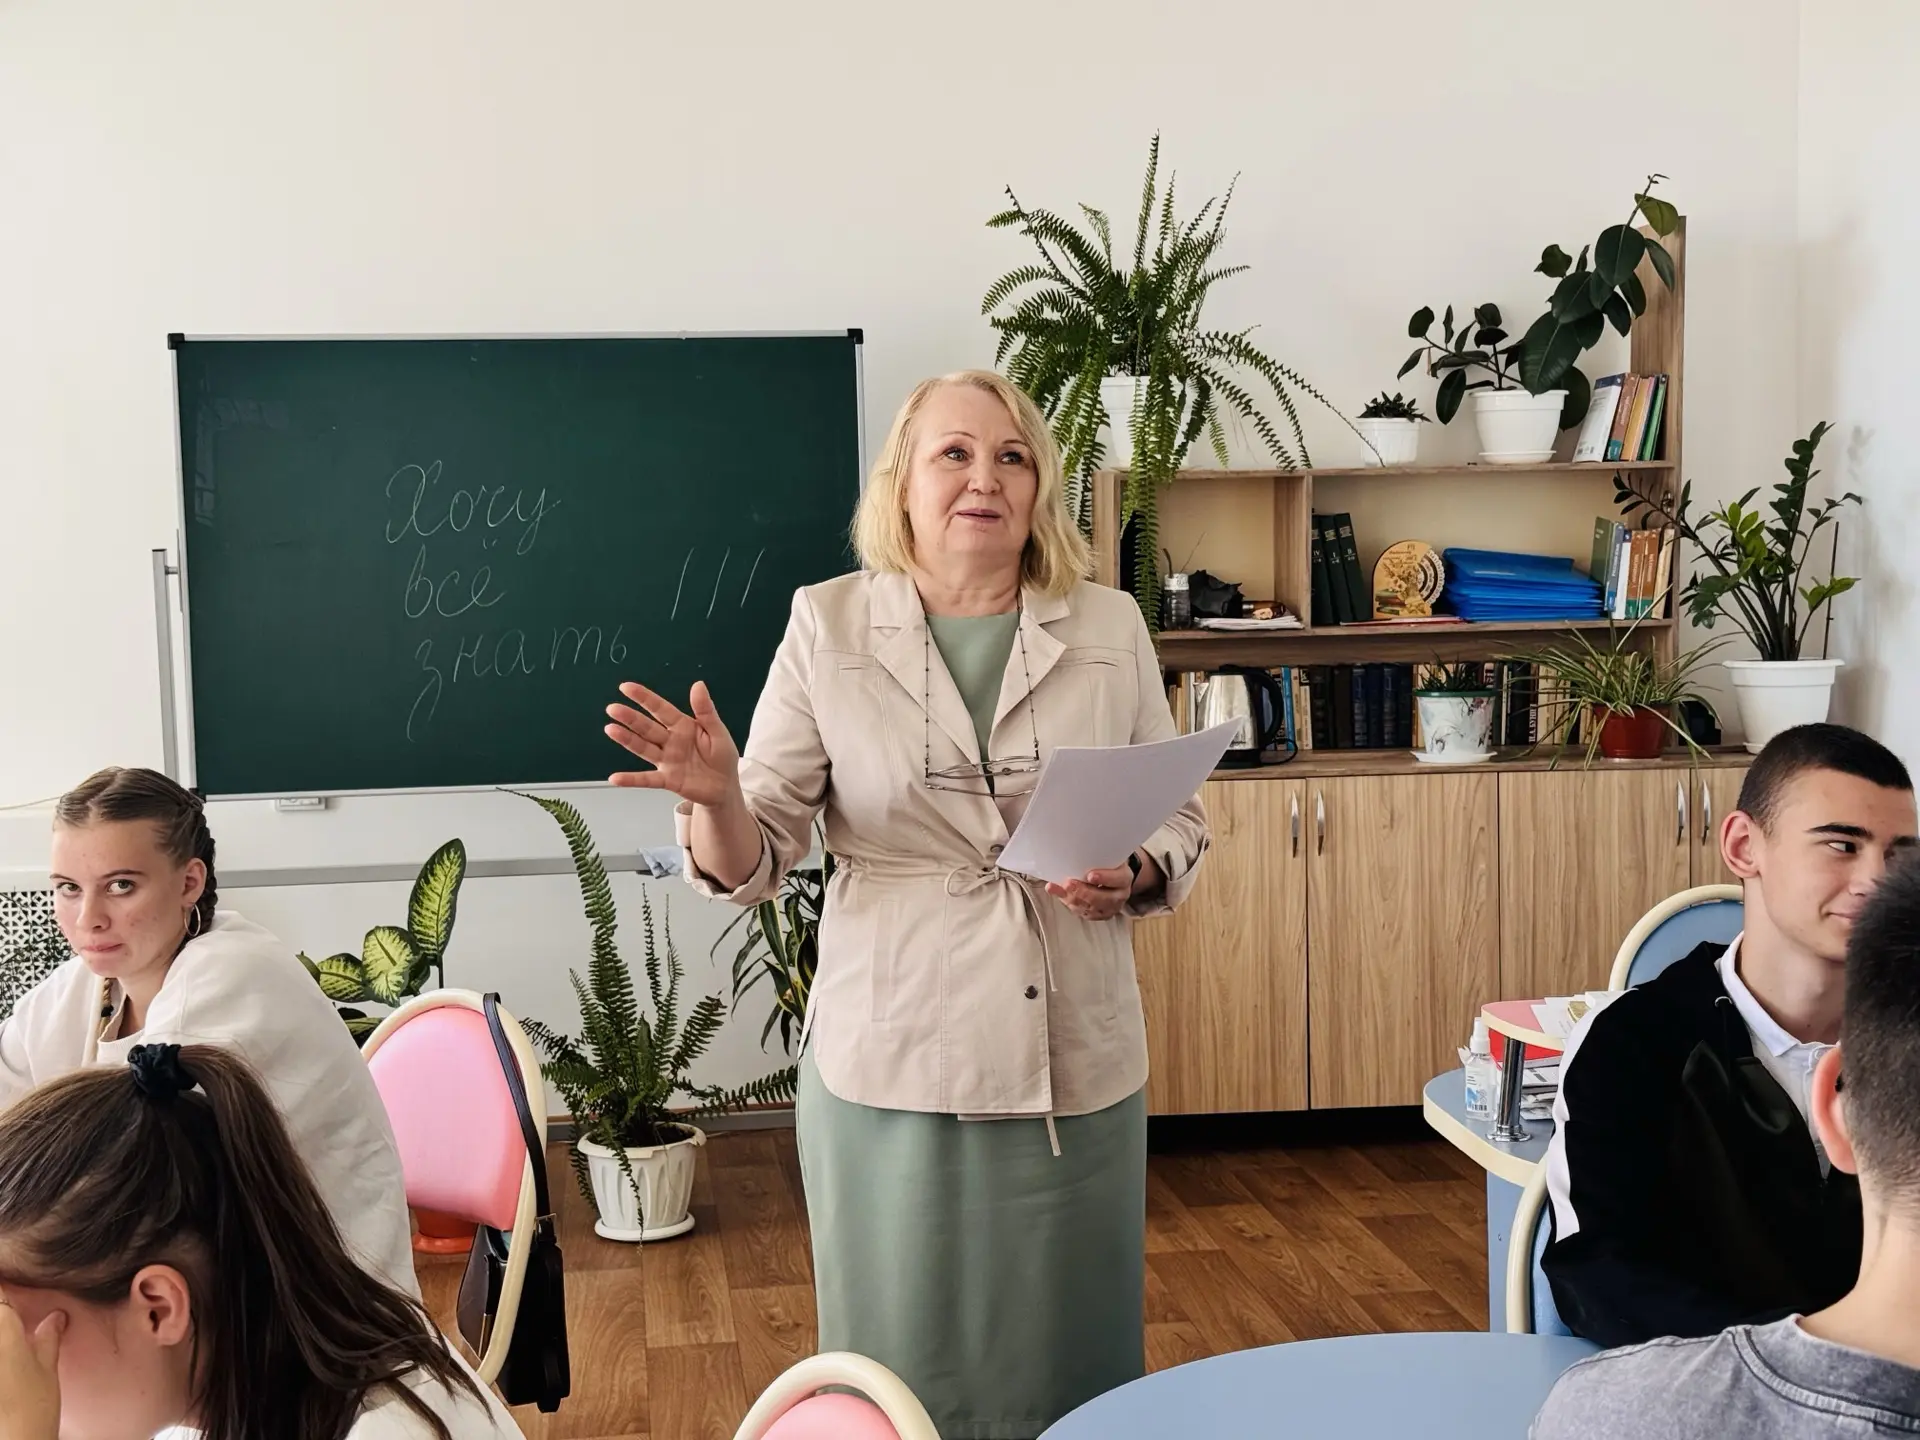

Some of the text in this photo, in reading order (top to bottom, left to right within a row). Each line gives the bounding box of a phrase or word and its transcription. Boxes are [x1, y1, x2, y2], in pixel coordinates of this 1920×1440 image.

[385, 459, 562, 556] Хочу
[404, 537, 508, 619] всё
[405, 624, 628, 743] знать
